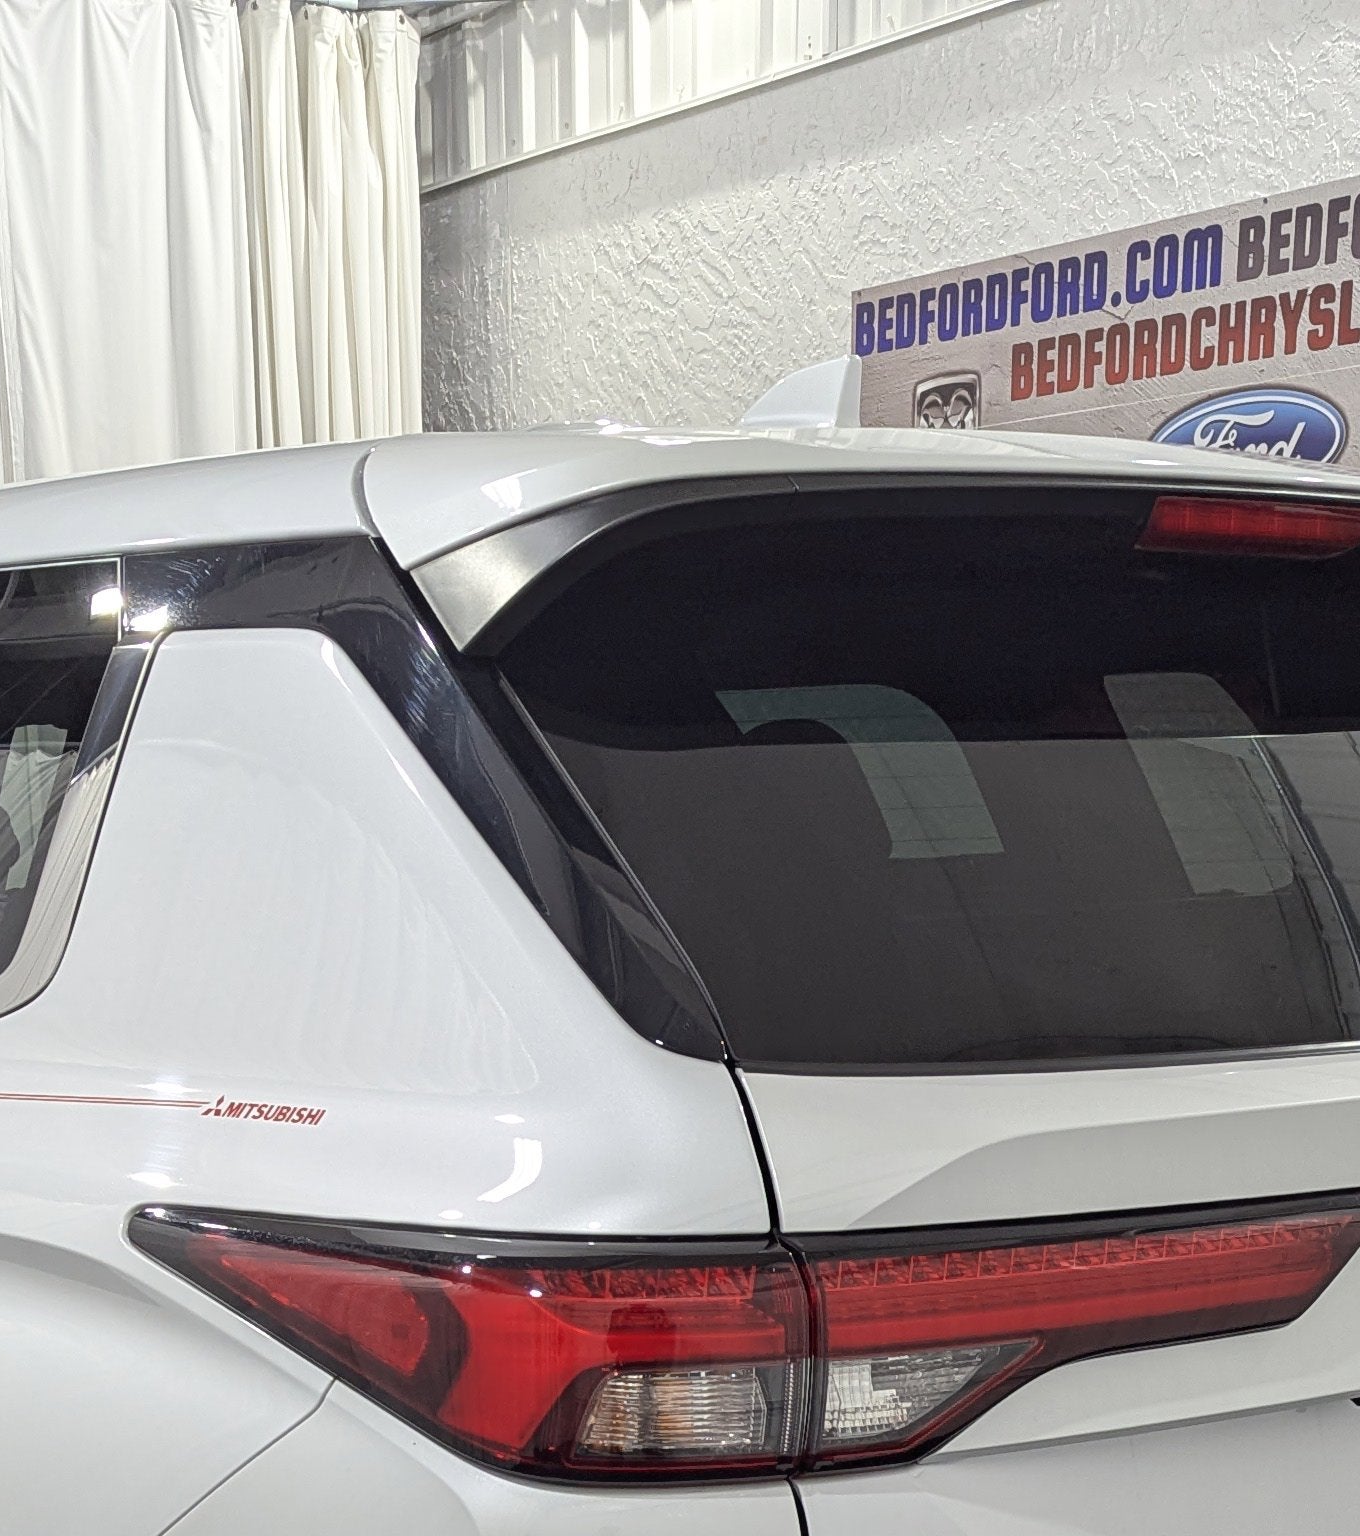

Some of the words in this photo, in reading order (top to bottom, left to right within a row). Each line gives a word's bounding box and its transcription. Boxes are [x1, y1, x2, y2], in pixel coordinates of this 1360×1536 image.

[855, 224, 1223, 358] BEDFORDFORD.COM
[1193, 409, 1306, 458] Frd
[221, 1101, 327, 1126] MITSUBISHI
